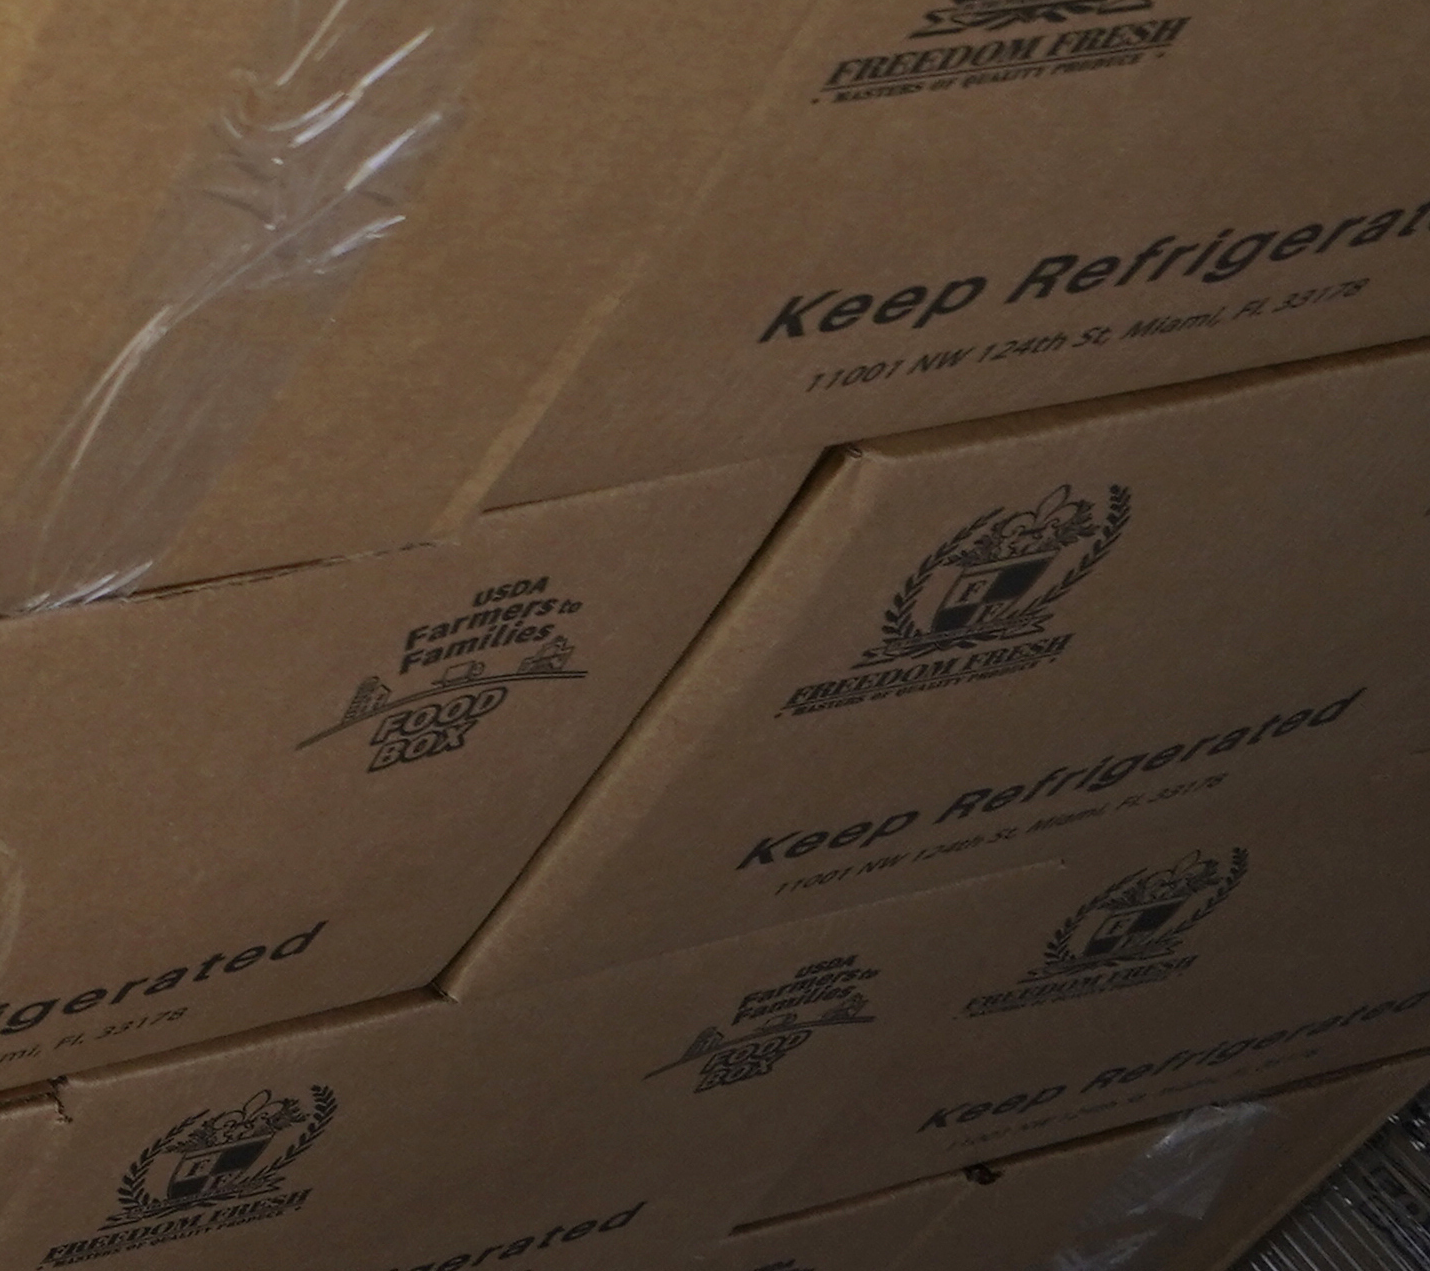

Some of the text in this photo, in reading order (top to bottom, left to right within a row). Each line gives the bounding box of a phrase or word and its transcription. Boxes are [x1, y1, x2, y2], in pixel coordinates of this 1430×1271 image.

[824, 16, 1191, 87] FREEDOM FRESH
[757, 201, 1430, 343] Keep Refrigerat
[805, 358, 909, 393] 11001
[907, 346, 979, 375] NW
[978, 333, 1067, 363] 124th
[473, 576, 550, 607] USDA
[399, 621, 555, 675] Families
[404, 598, 583, 650] Farmers to
[786, 658, 957, 707] FREEDOM
[962, 633, 1075, 670] FRESH
[370, 687, 508, 746] FOOD
[367, 719, 479, 773] BOX
[734, 809, 919, 871] Keep
[934, 687, 1368, 825] Refrigerated
[739, 969, 860, 1008] Farmers
[795, 954, 858, 979] USDA
[101, 1007, 189, 1039] 33178
[732, 985, 856, 1026] Families
[916, 1084, 1067, 1133] Keep
[45, 1214, 203, 1263] FREEDOM
[209, 1189, 312, 1224] FRESH
